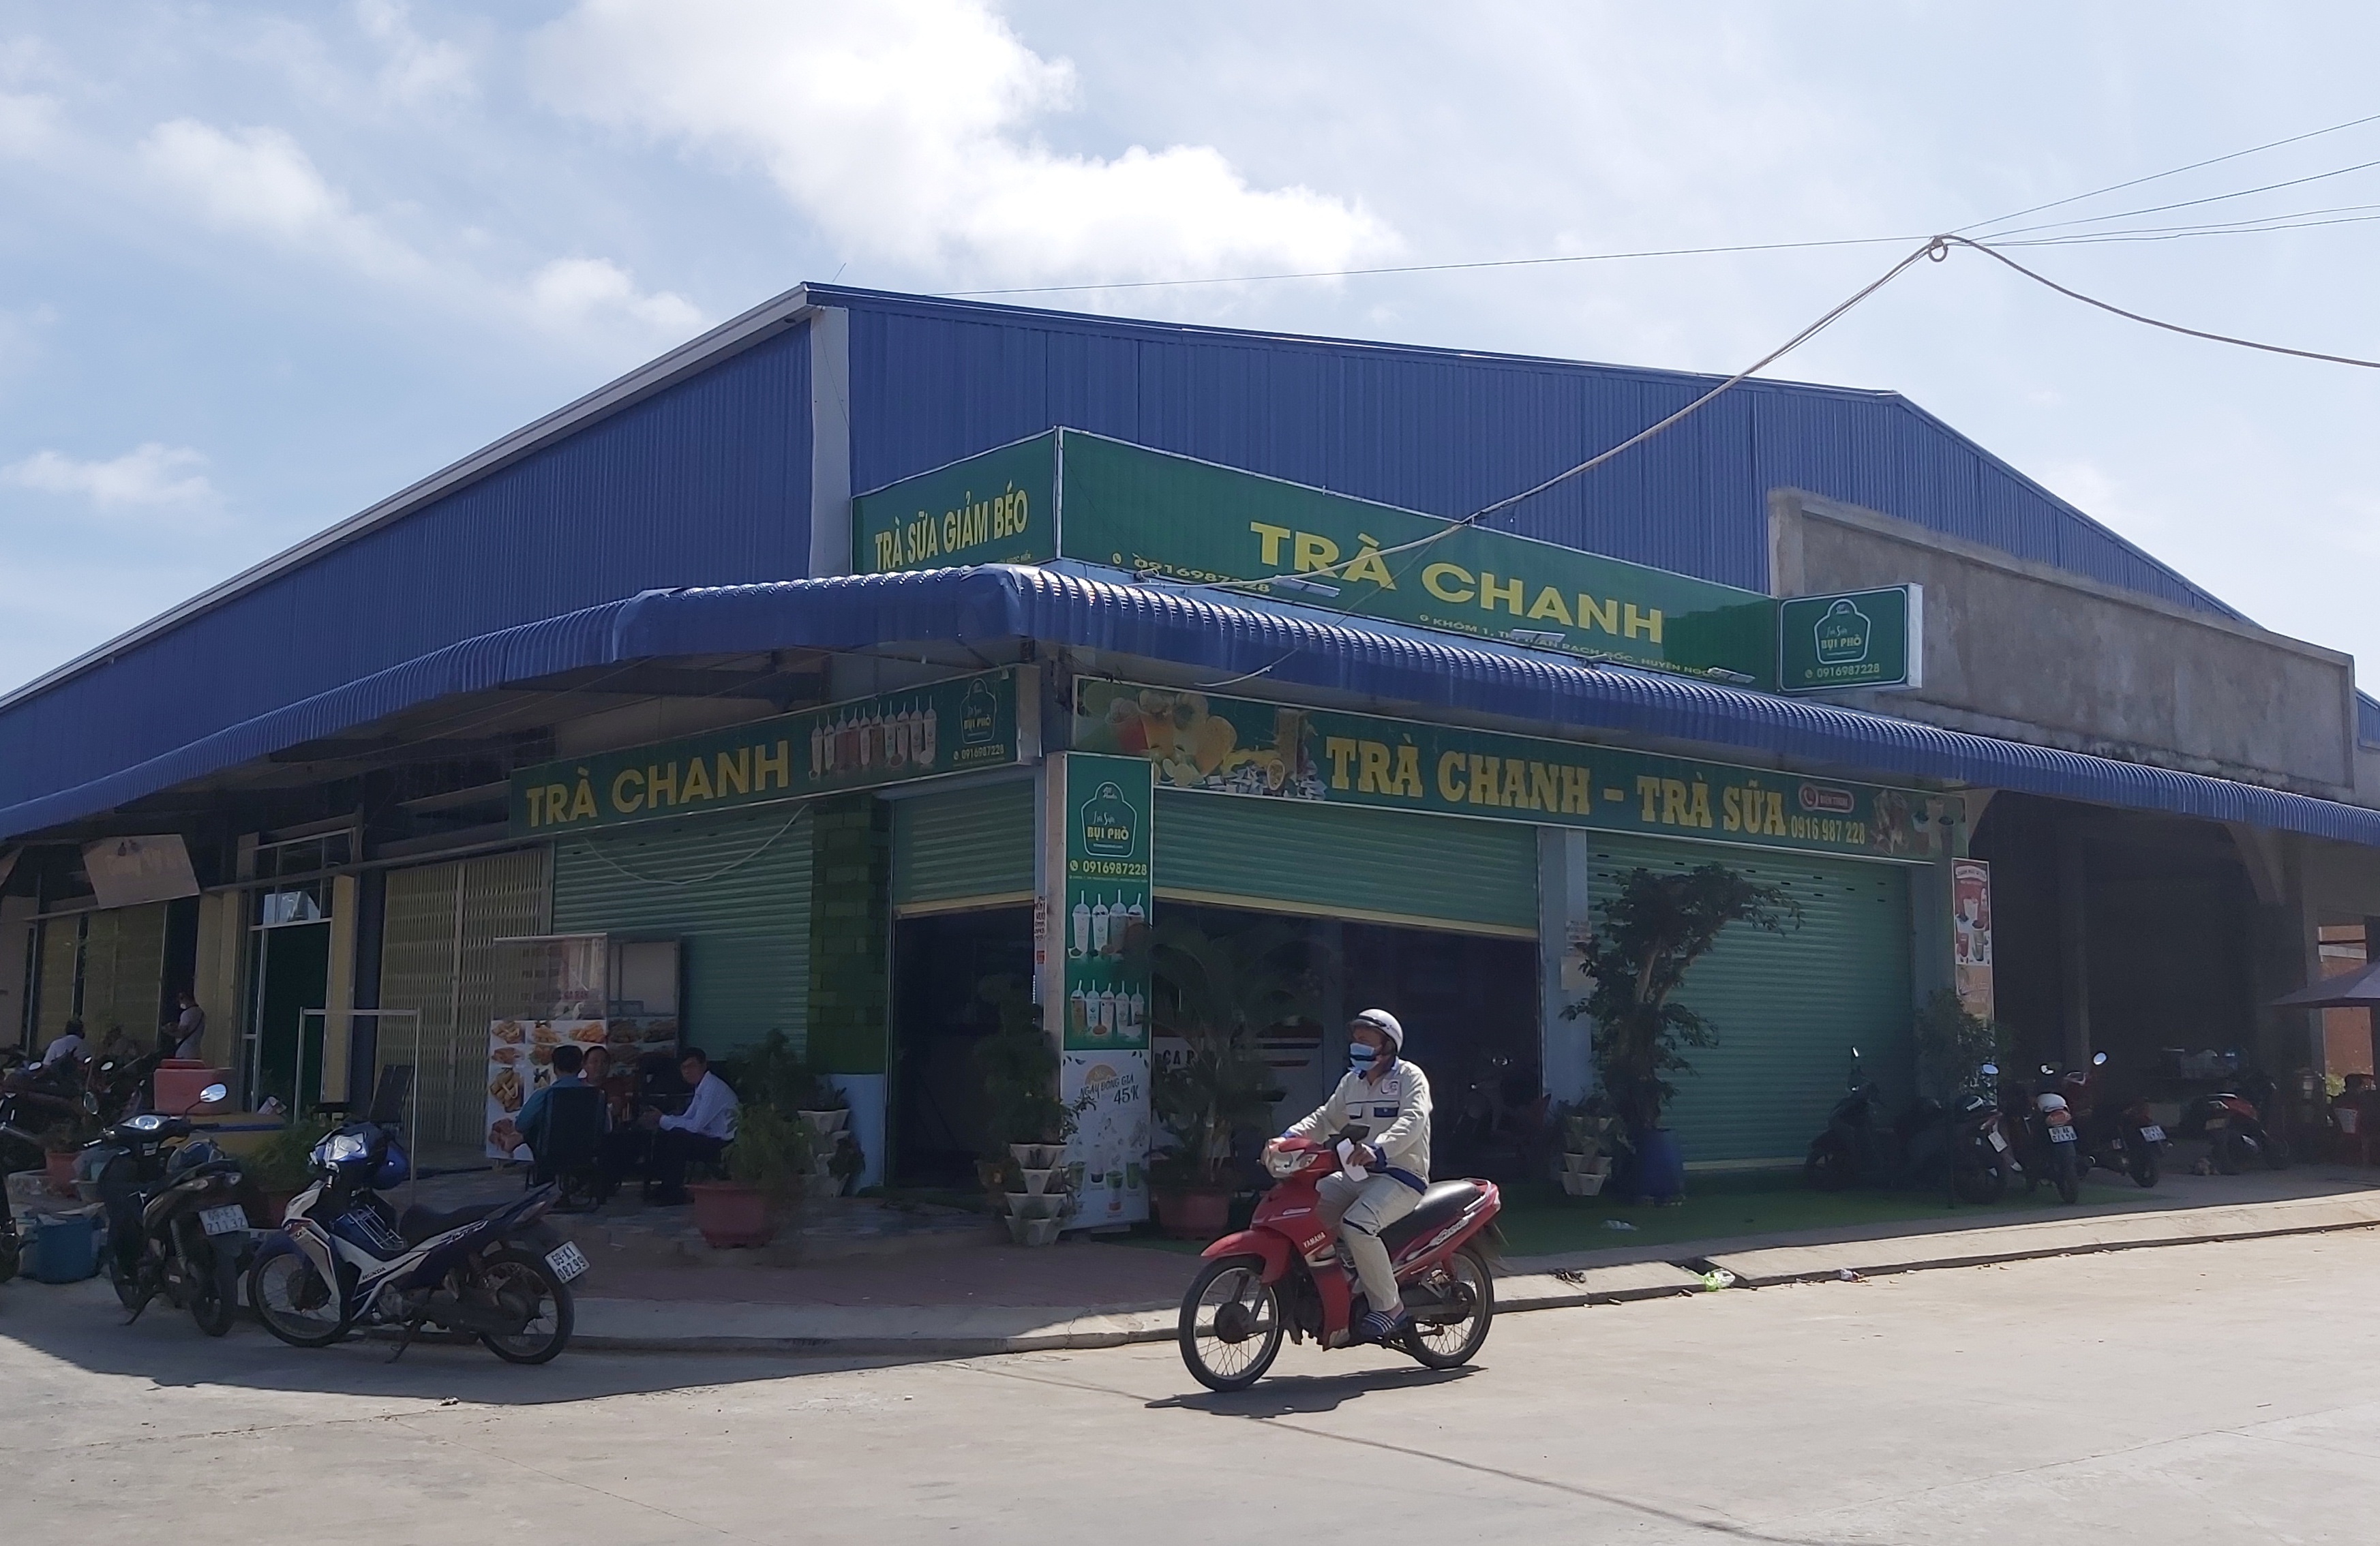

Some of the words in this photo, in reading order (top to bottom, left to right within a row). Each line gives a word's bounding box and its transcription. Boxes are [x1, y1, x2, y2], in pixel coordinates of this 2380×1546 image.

[875, 516, 903, 571] TRÀ
[908, 511, 938, 563] SỮA
[944, 491, 988, 553] GIẢM
[994, 480, 1027, 539] BÉO
[1250, 521, 1397, 590] TRÀ
[1421, 562, 1662, 643] CHANH
[1817, 663, 1880, 678] 0916987228
[527, 766, 597, 828] TRÀ
[614, 740, 788, 813] CHANH
[1326, 733, 1423, 798] TRÀ
[1438, 751, 1590, 815] CHANH
[1637, 772, 1712, 828] TRÀ
[1723, 779, 1786, 836] SỮA
[1087, 825, 1104, 841] BỤI
[1791, 815, 1818, 840] 0916
[1822, 818, 1842, 842] 987
[1846, 821, 1865, 845] 228
[1083, 860, 1147, 875] 0916987228
[1303, 1231, 1326, 1249] YAMAHA
